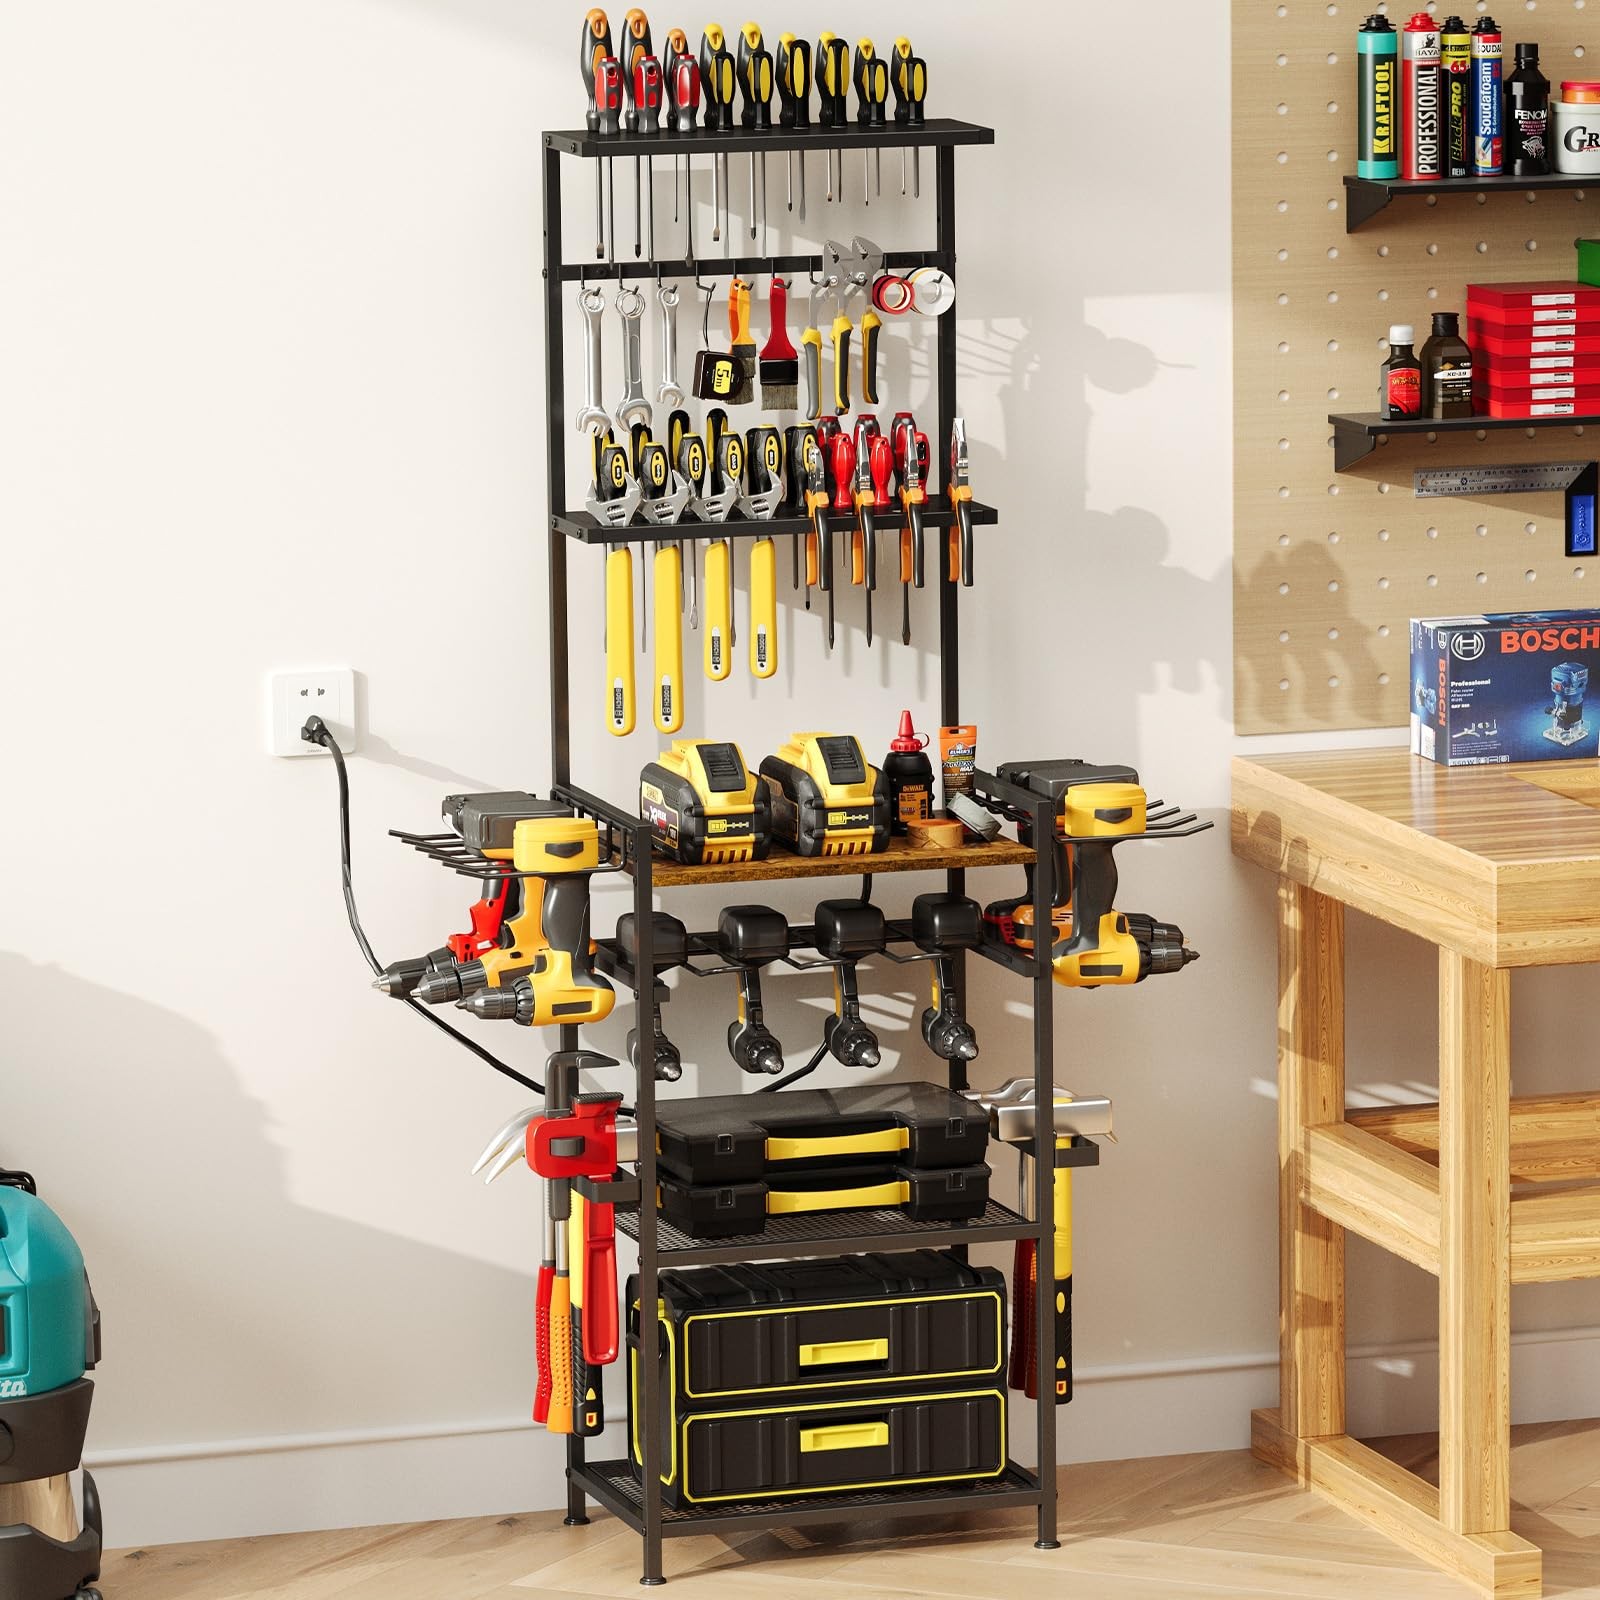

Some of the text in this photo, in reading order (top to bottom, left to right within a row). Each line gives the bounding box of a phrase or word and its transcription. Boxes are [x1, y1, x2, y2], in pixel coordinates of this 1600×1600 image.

[1373, 61, 1390, 154] KRAFTOOL
[1417, 66, 1437, 174] PROFESSIONAL
[1480, 62, 1492, 136] Soudafoam
[716, 368, 730, 388] 5m
[1500, 627, 1600, 654] BOSCH
[1438, 658, 1447, 727] BOSCH
[1450, 678, 1491, 687] Professional
